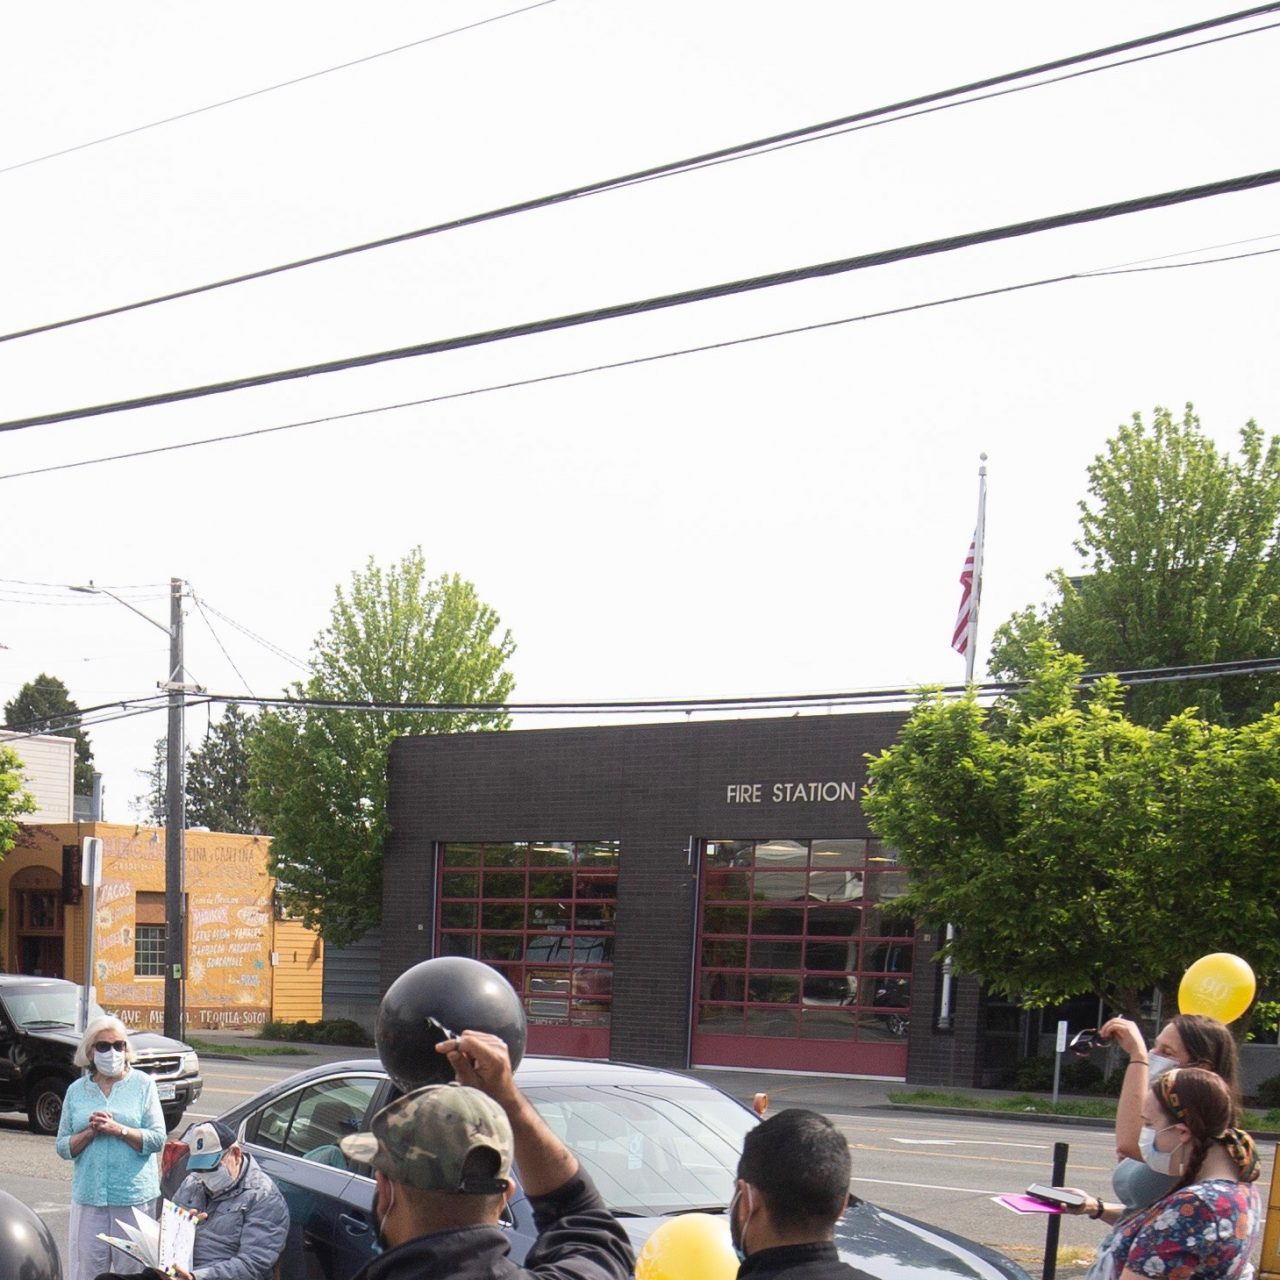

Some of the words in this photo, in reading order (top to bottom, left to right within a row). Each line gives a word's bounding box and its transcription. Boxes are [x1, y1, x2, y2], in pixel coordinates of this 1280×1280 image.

[726, 784, 762, 804] FIRE
[771, 781, 856, 803] STATION
[99, 881, 132, 904] TACOS
[1200, 975, 1229, 1000] 90
[199, 1010, 239, 1024] TEQUILA
